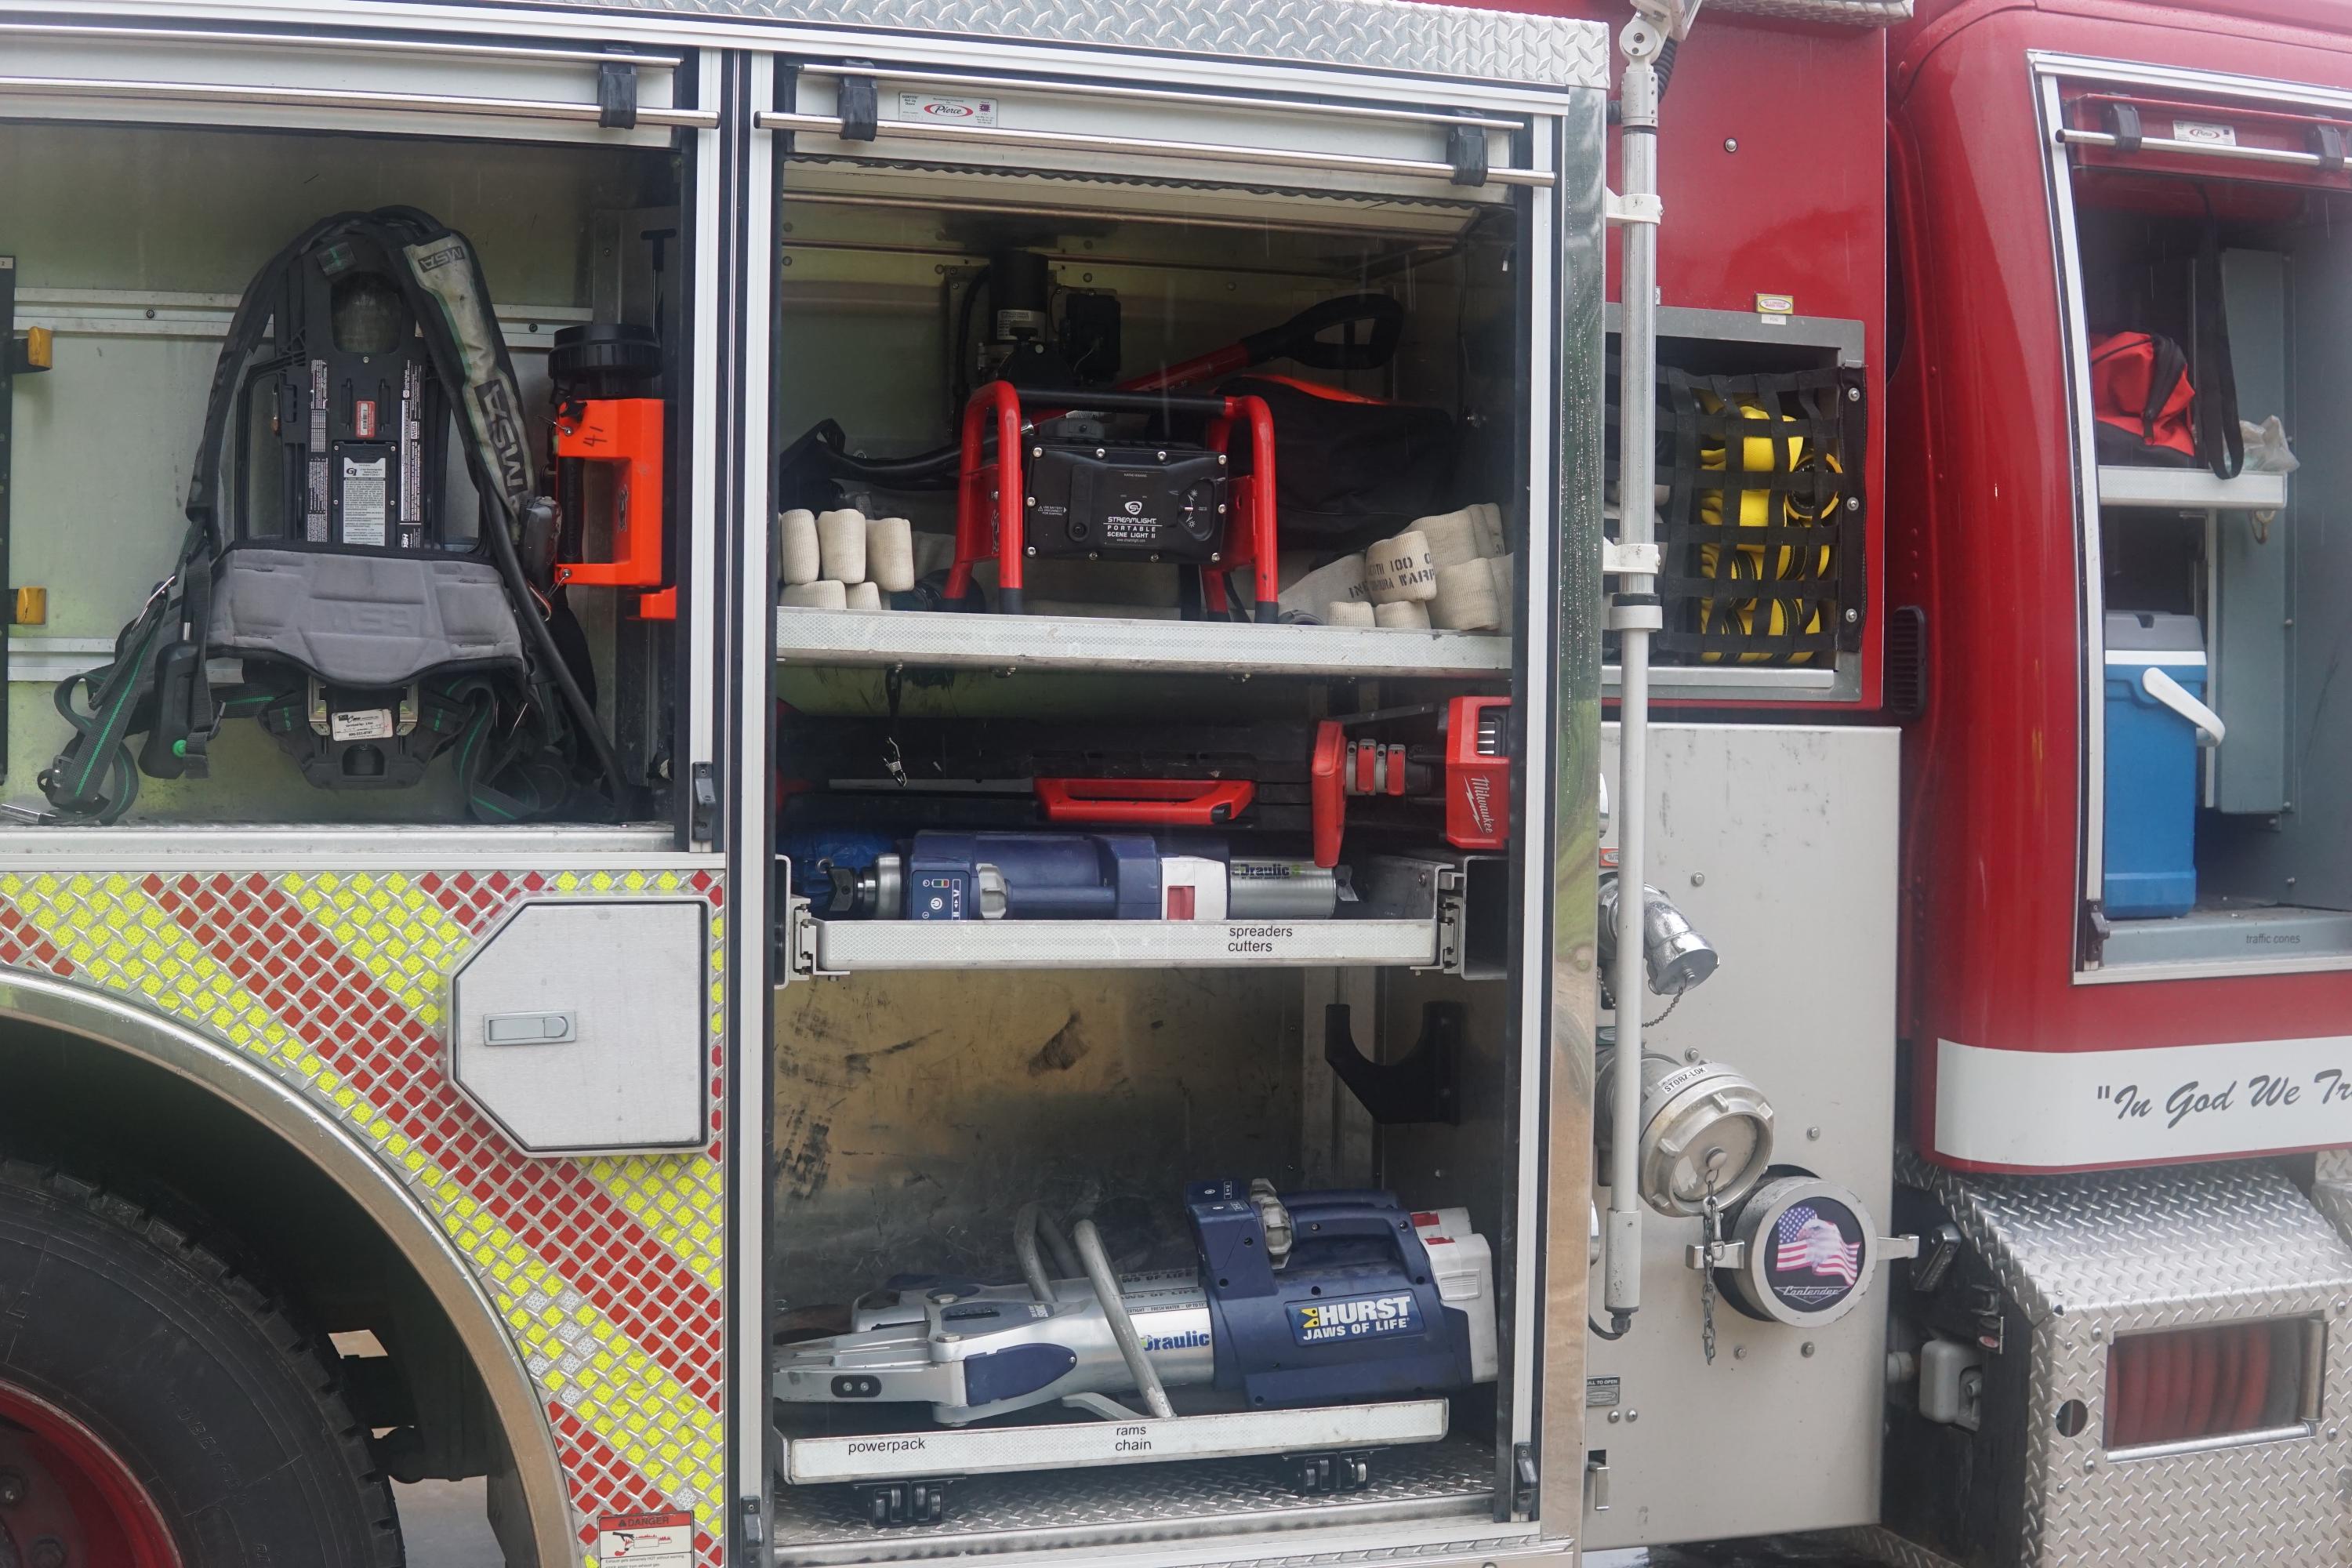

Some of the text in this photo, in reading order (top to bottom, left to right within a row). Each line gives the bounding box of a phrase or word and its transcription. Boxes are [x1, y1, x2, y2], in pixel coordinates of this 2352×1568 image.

[934, 105, 962, 114] Pierce
[421, 246, 464, 270] MSA
[482, 383, 524, 489] MSA
[1107, 516, 1156, 524] STREAMLIGHT
[1470, 774, 1495, 833] Milwaukee
[1229, 925, 1293, 939] spreaders
[2245, 933, 2301, 944] traffic cones
[1228, 940, 1272, 952] cutters
[1664, 1066, 1707, 1092] STORZ-LOK
[2165, 1080, 2237, 1129] God
[2248, 1074, 2301, 1108] We
[1783, 1285, 1840, 1296] Contender
[1318, 1295, 1410, 1327] HURST
[1303, 1325, 1346, 1341] JAWS
[1351, 1323, 1370, 1334] OF
[1116, 1425, 1147, 1437] rams
[848, 1437, 926, 1455] powerpack
[1114, 1438, 1152, 1451] chain
[627, 1516, 670, 1527] DANGER
